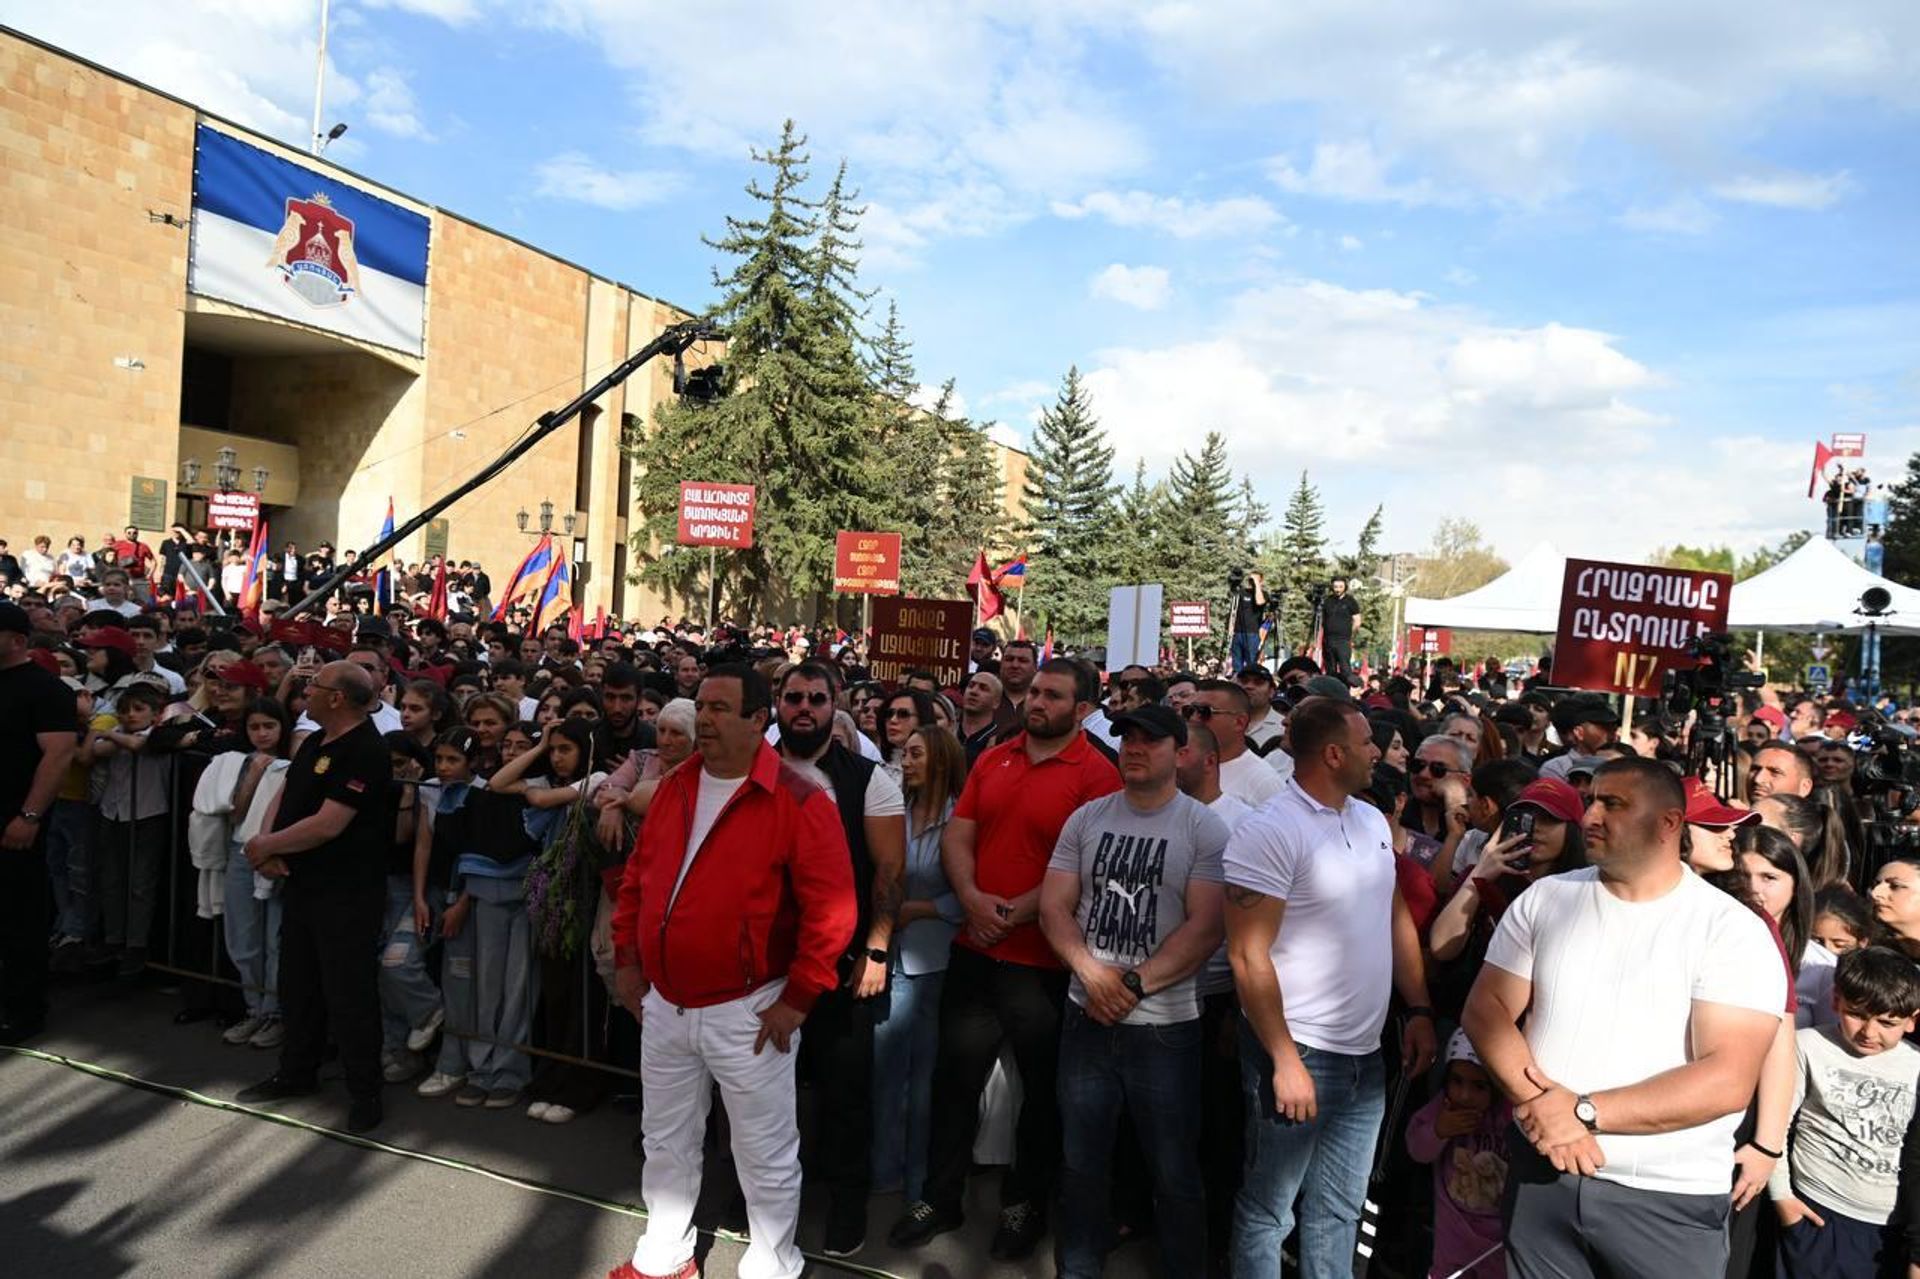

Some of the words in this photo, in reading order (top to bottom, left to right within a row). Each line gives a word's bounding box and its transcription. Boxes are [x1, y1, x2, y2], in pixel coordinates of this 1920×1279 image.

[1576, 567, 1719, 611] ՀՐԱԶԴԱՆԸ
[1572, 607, 1690, 649] ԸՆՏՐՈՒՄ
[1613, 651, 1658, 690] N7
